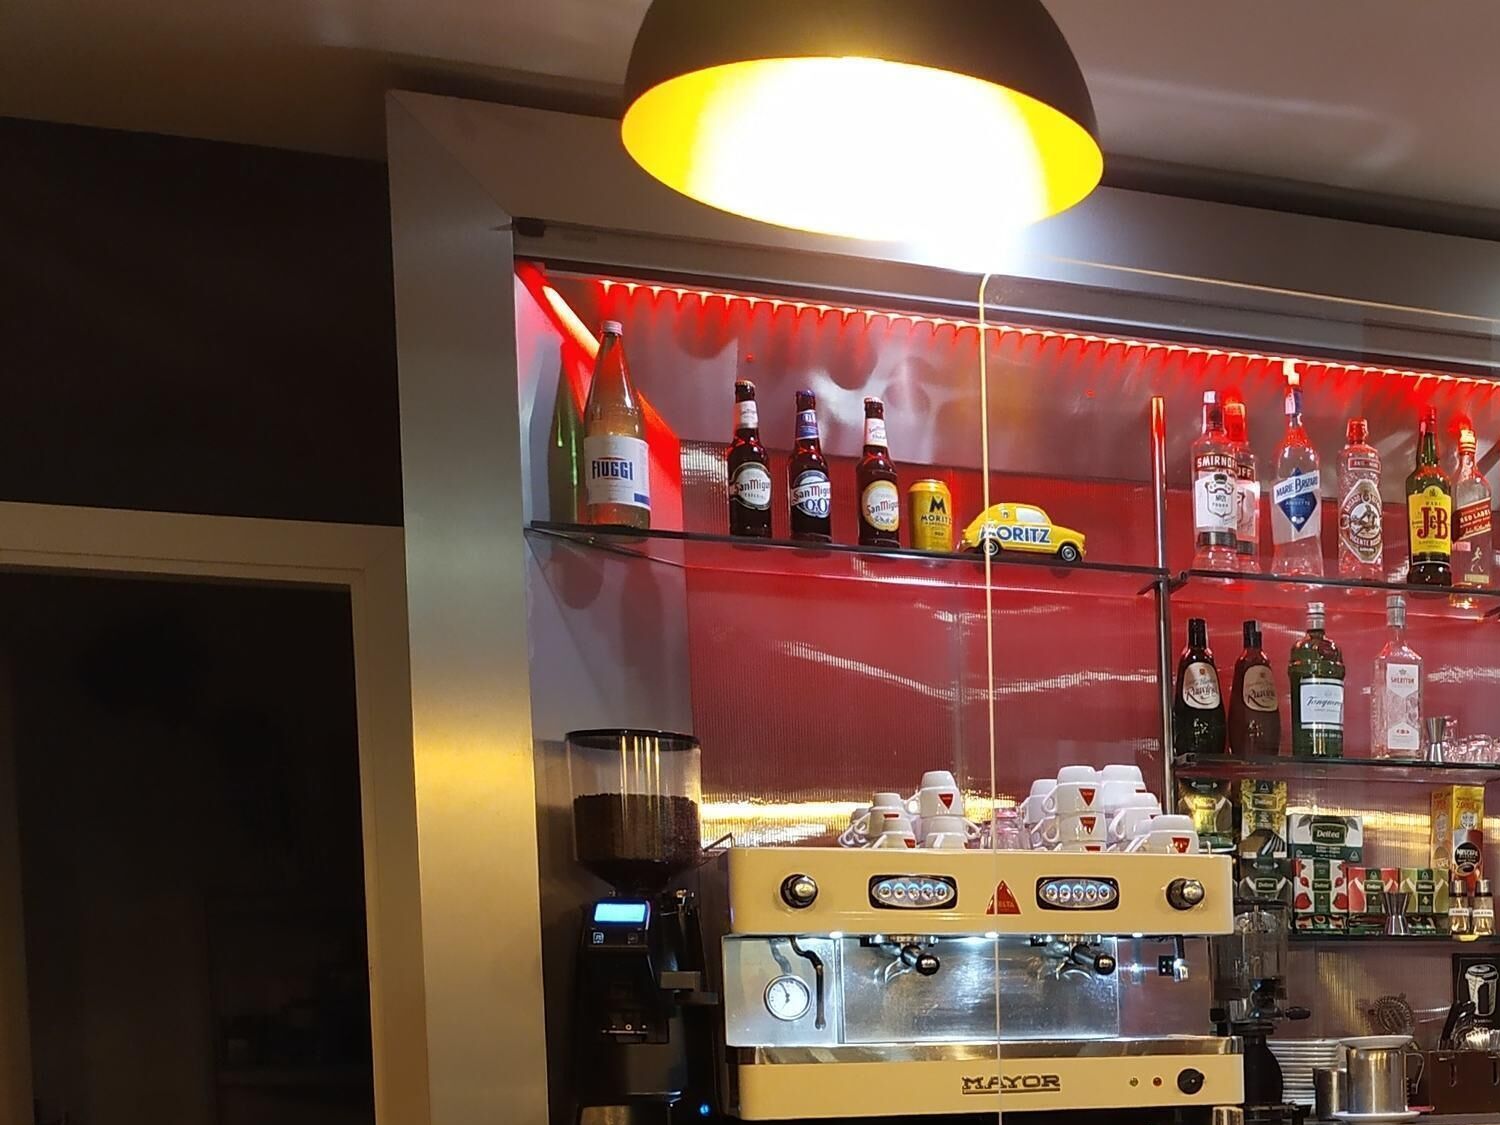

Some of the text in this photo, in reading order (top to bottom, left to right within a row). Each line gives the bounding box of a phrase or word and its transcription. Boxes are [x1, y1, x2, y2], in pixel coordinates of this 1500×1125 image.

[591, 460, 634, 481] FIUGGI
[1276, 483, 1295, 496] MARIE
[929, 496, 946, 513] M
[921, 514, 952, 525] MORITZ
[1417, 507, 1448, 539] J&B
[961, 1075, 1060, 1089] MAYOR
